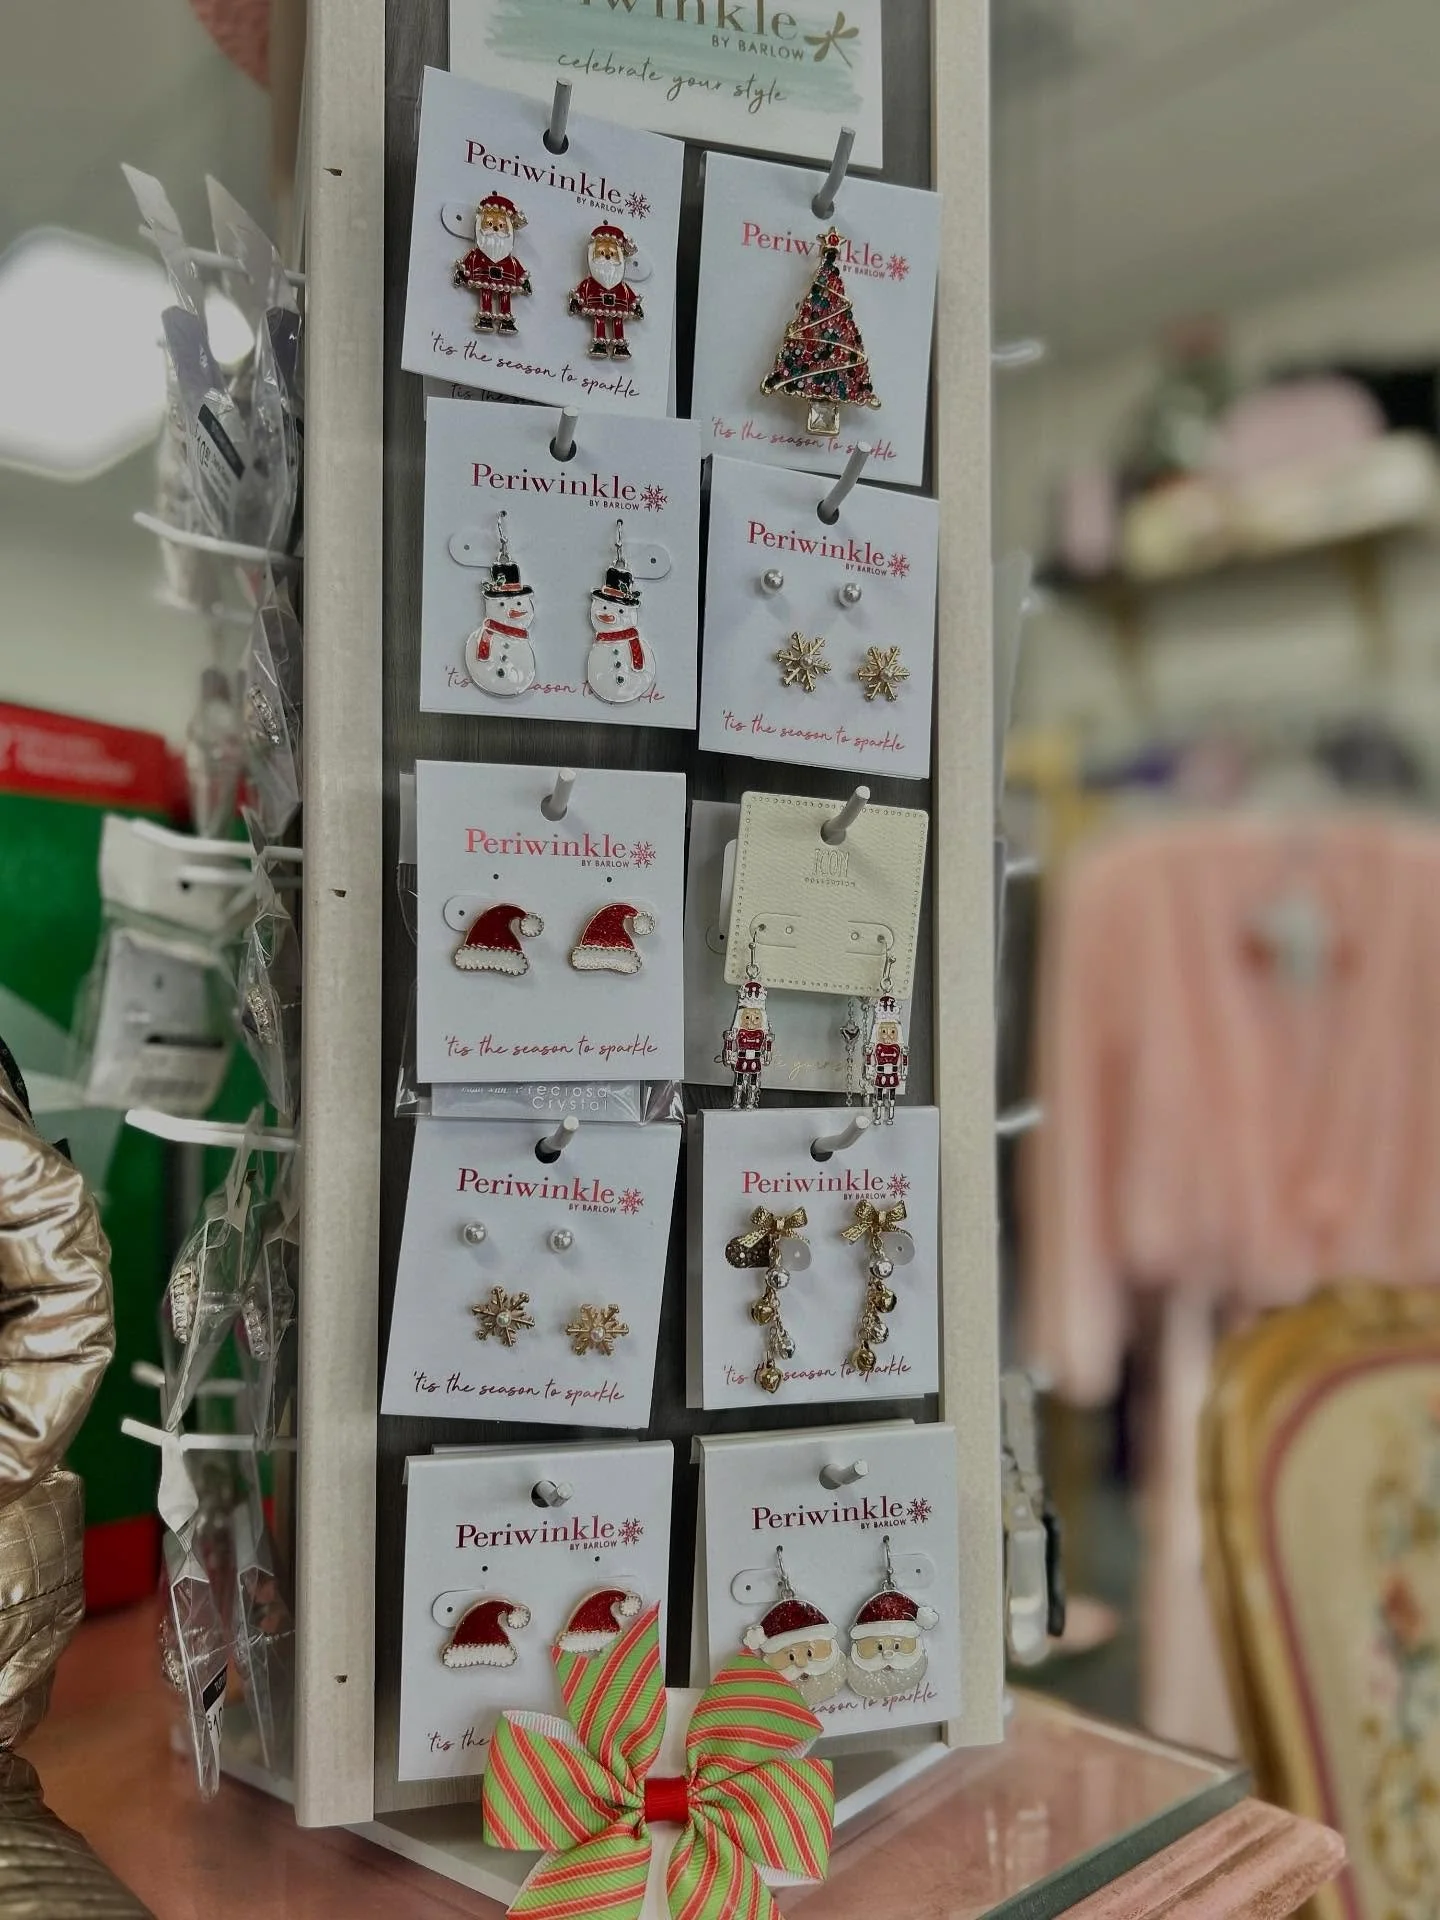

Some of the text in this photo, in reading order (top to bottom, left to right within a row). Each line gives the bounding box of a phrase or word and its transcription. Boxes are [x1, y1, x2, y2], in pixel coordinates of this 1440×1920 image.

[712, 35, 804, 60] BY BARLOW
[557, 49, 788, 114] celebrate your style
[464, 140, 621, 204] Periwinkle
[576, 196, 625, 216] BY BARLOW
[741, 222, 884, 269] Periwkle
[464, 340, 492, 362] the
[496, 357, 557, 378] season
[560, 364, 577, 383] to
[581, 376, 641, 398] sparkle
[741, 420, 767, 441] the
[471, 463, 637, 500] Periwinkle
[603, 501, 640, 510] BARLOW
[747, 520, 885, 567] Periwinkle
[845, 563, 888, 577] BY BARLOW
[752, 713, 778, 734] the
[780, 726, 833, 741] season
[836, 725, 850, 744] to
[854, 731, 906, 752] sparkle
[465, 828, 627, 859] Periwinkle
[595, 860, 630, 868] BARLOW
[479, 1034, 509, 1057] the
[512, 1045, 574, 1057] season
[577, 1035, 595, 1057] to
[598, 1034, 658, 1061] sparkle
[532, 1096, 608, 1112] Crystal
[456, 1167, 615, 1204] Periwinkle
[742, 1169, 884, 1193] Periwinkle
[568, 1203, 617, 1213] BY BARLOW
[855, 1192, 887, 1200] BARLOW
[446, 1372, 476, 1394] the
[479, 1385, 541, 1396] season
[544, 1378, 562, 1398] to
[565, 1380, 625, 1406] sparkle
[752, 1496, 903, 1531] Periwinkle
[860, 1519, 907, 1530] BY BARLOW
[455, 1515, 615, 1548] Periwinkle
[569, 1540, 618, 1550] BY BARLOW
[882, 1682, 938, 1713] sparkle
[461, 1727, 490, 1750] the
